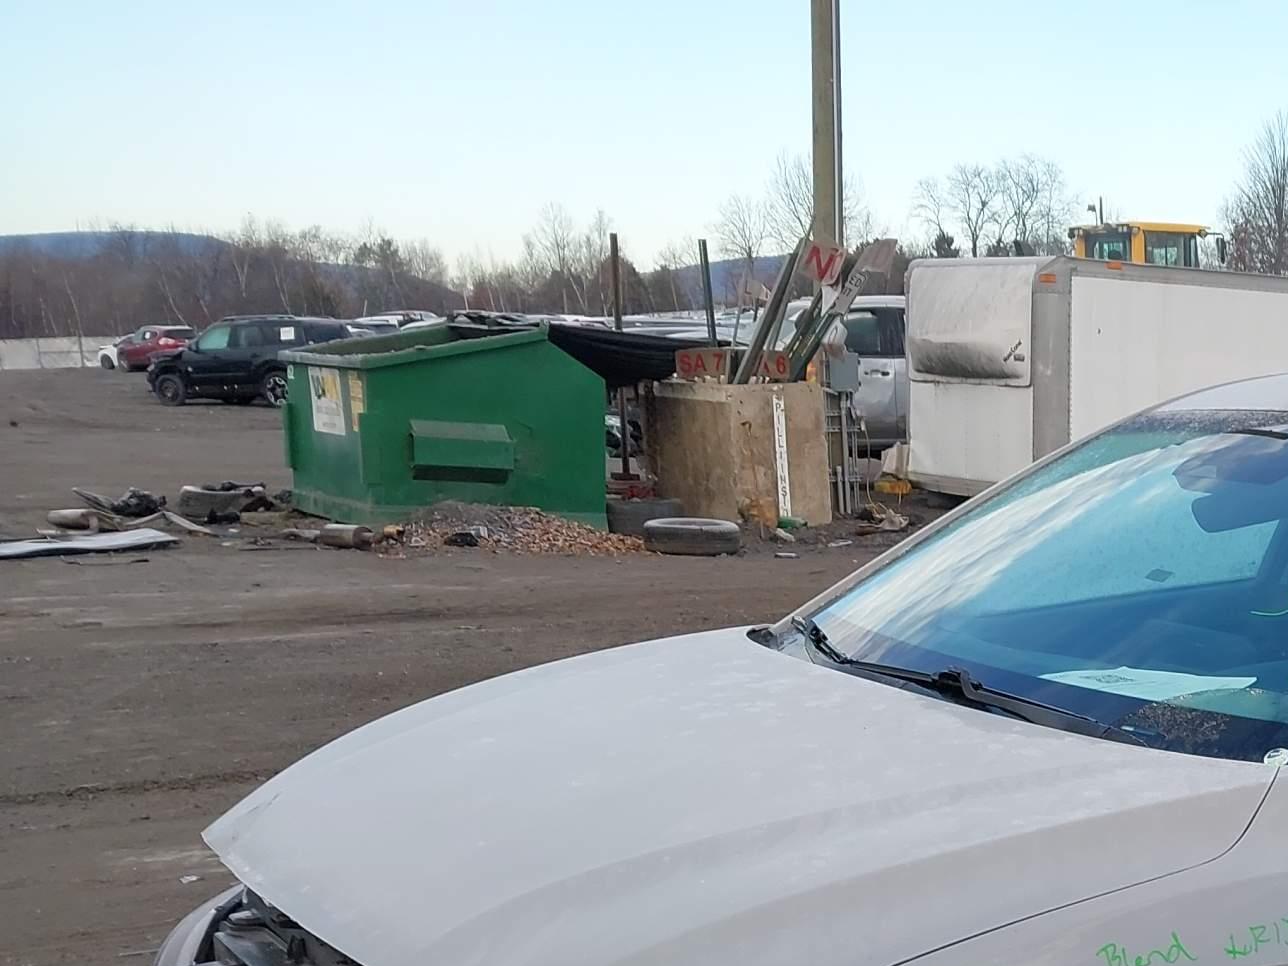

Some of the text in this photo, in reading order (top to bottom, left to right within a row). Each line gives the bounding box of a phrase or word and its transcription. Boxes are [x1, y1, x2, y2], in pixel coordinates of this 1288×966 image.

[679, 352, 723, 374] SA 7
[776, 355, 786, 375] 6
